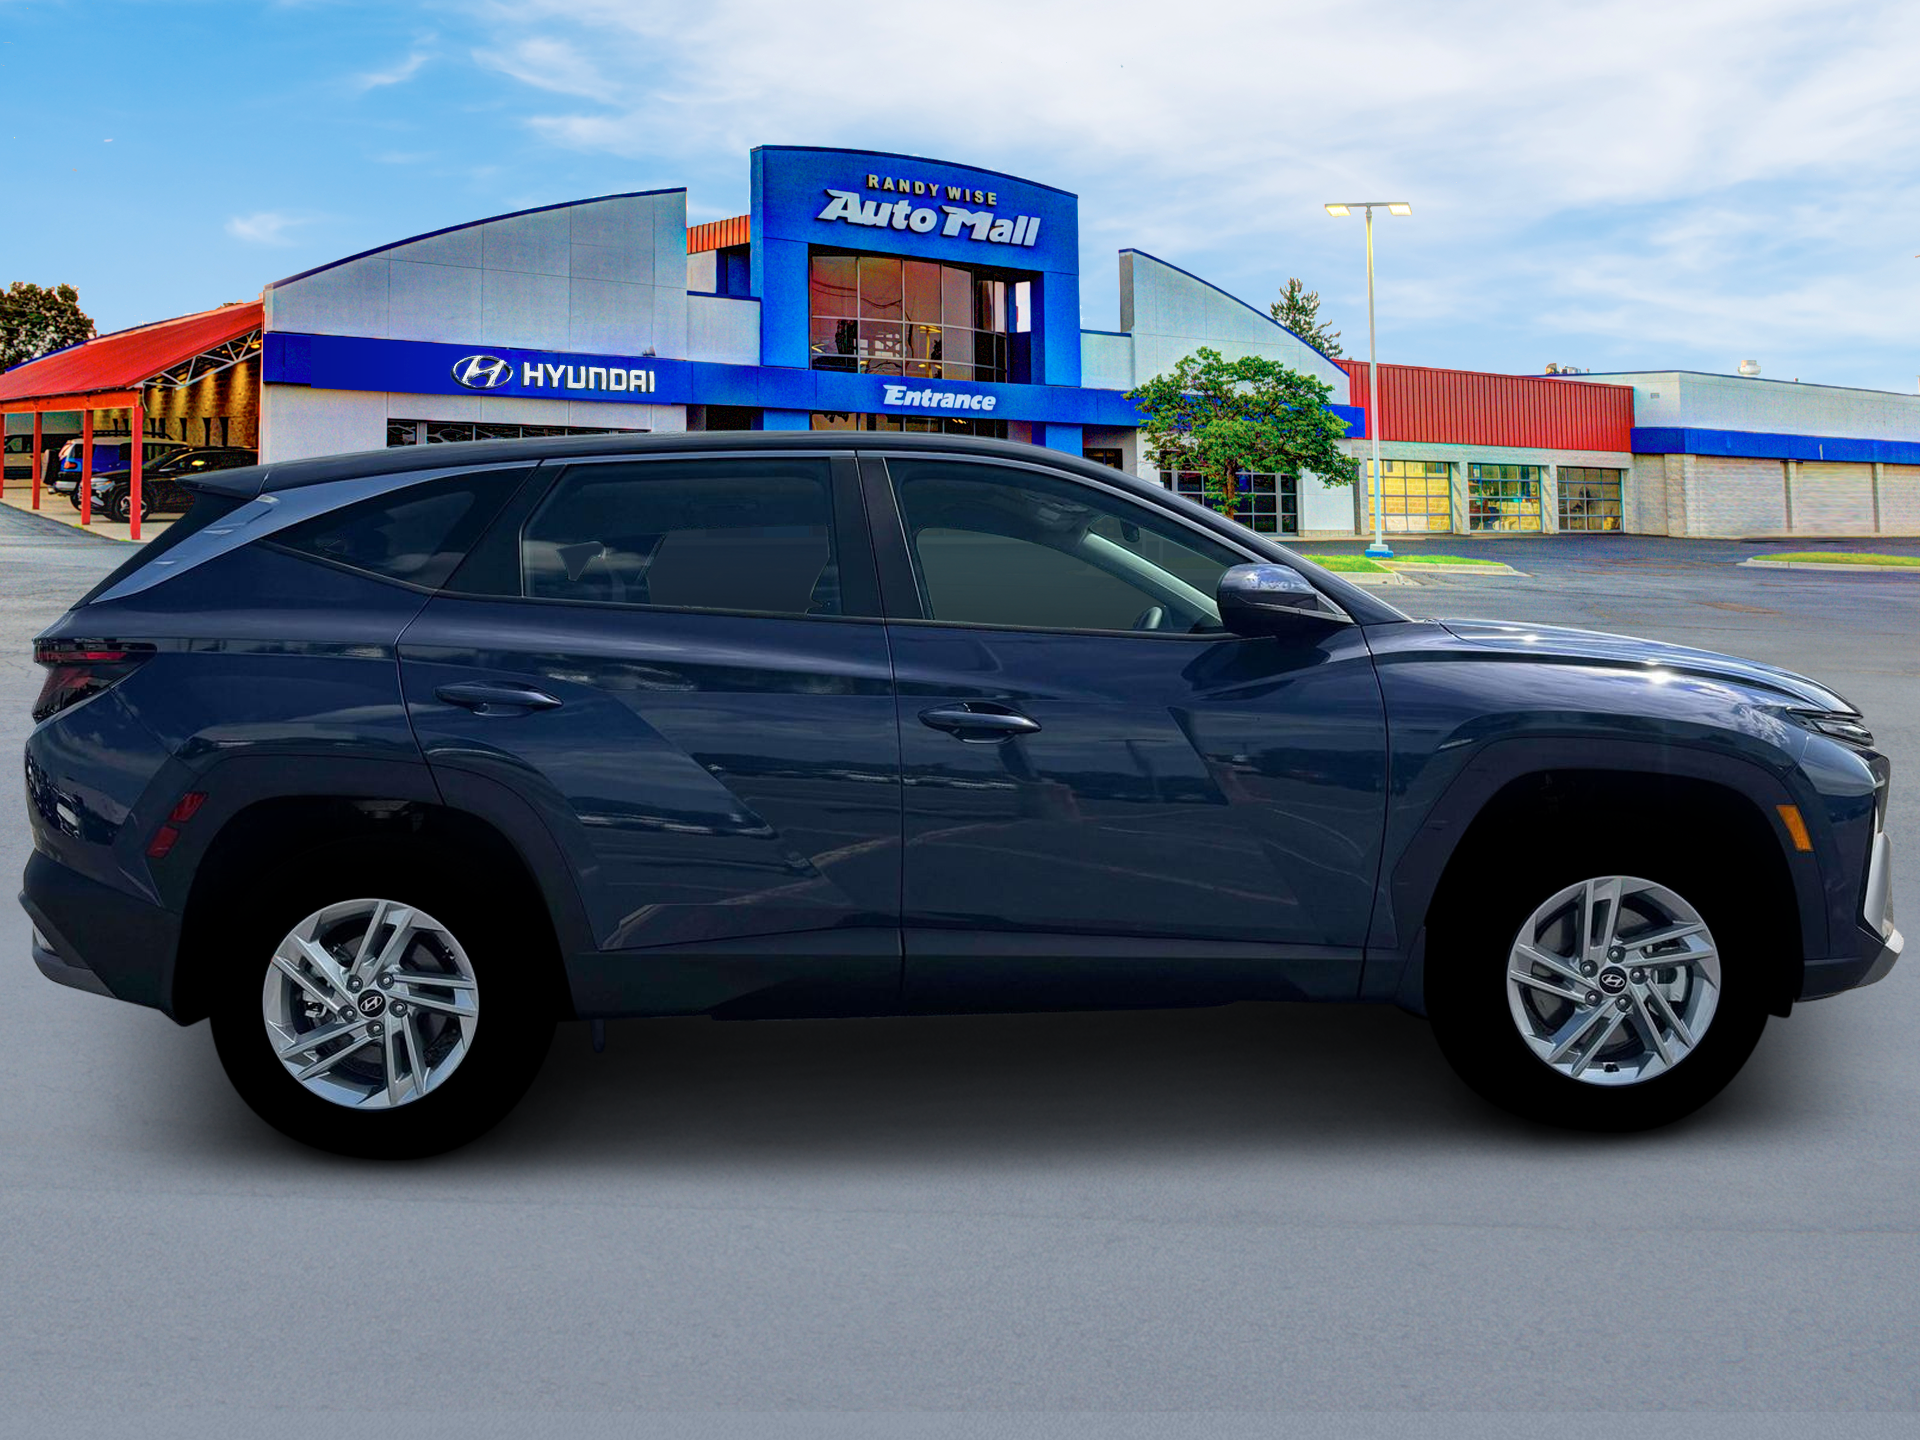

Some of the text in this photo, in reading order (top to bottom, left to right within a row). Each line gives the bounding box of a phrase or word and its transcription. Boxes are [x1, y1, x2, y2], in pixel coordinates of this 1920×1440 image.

[866, 174, 997, 206] RANDY WISE
[816, 188, 1041, 246] Auto Mall
[521, 362, 656, 393] HYUNDAI
[882, 384, 996, 411] Entrance
